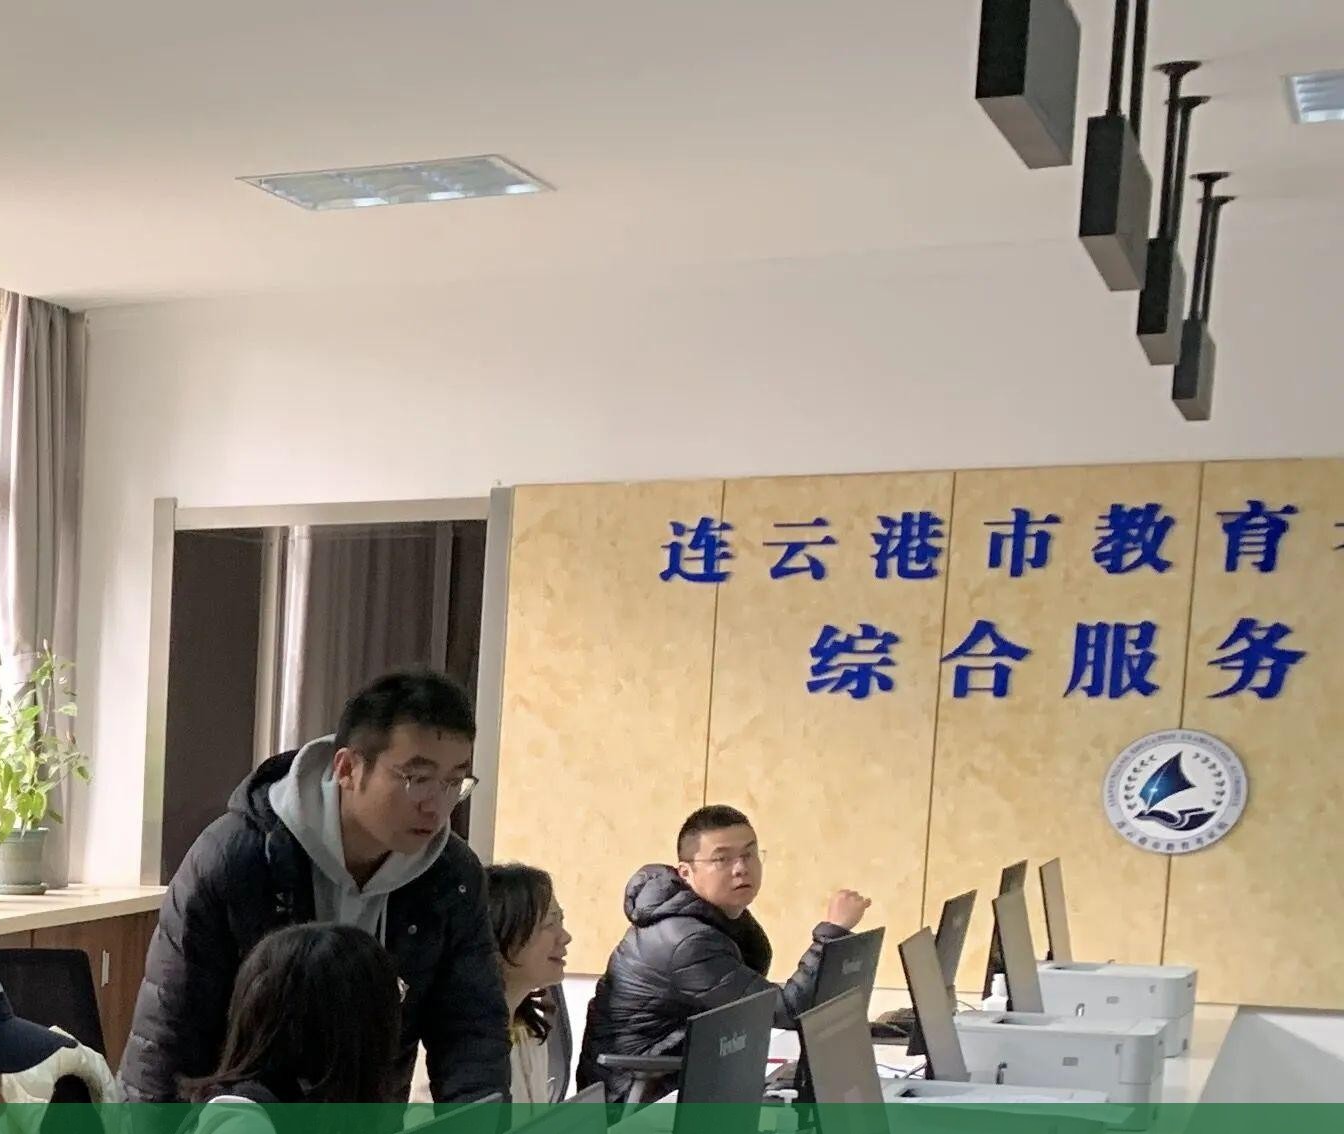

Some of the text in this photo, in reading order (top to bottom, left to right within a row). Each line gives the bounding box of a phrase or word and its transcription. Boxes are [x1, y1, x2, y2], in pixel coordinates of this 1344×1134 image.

[660, 500, 1344, 583] 连云港市教育
[807, 618, 1305, 700] 综合服务
